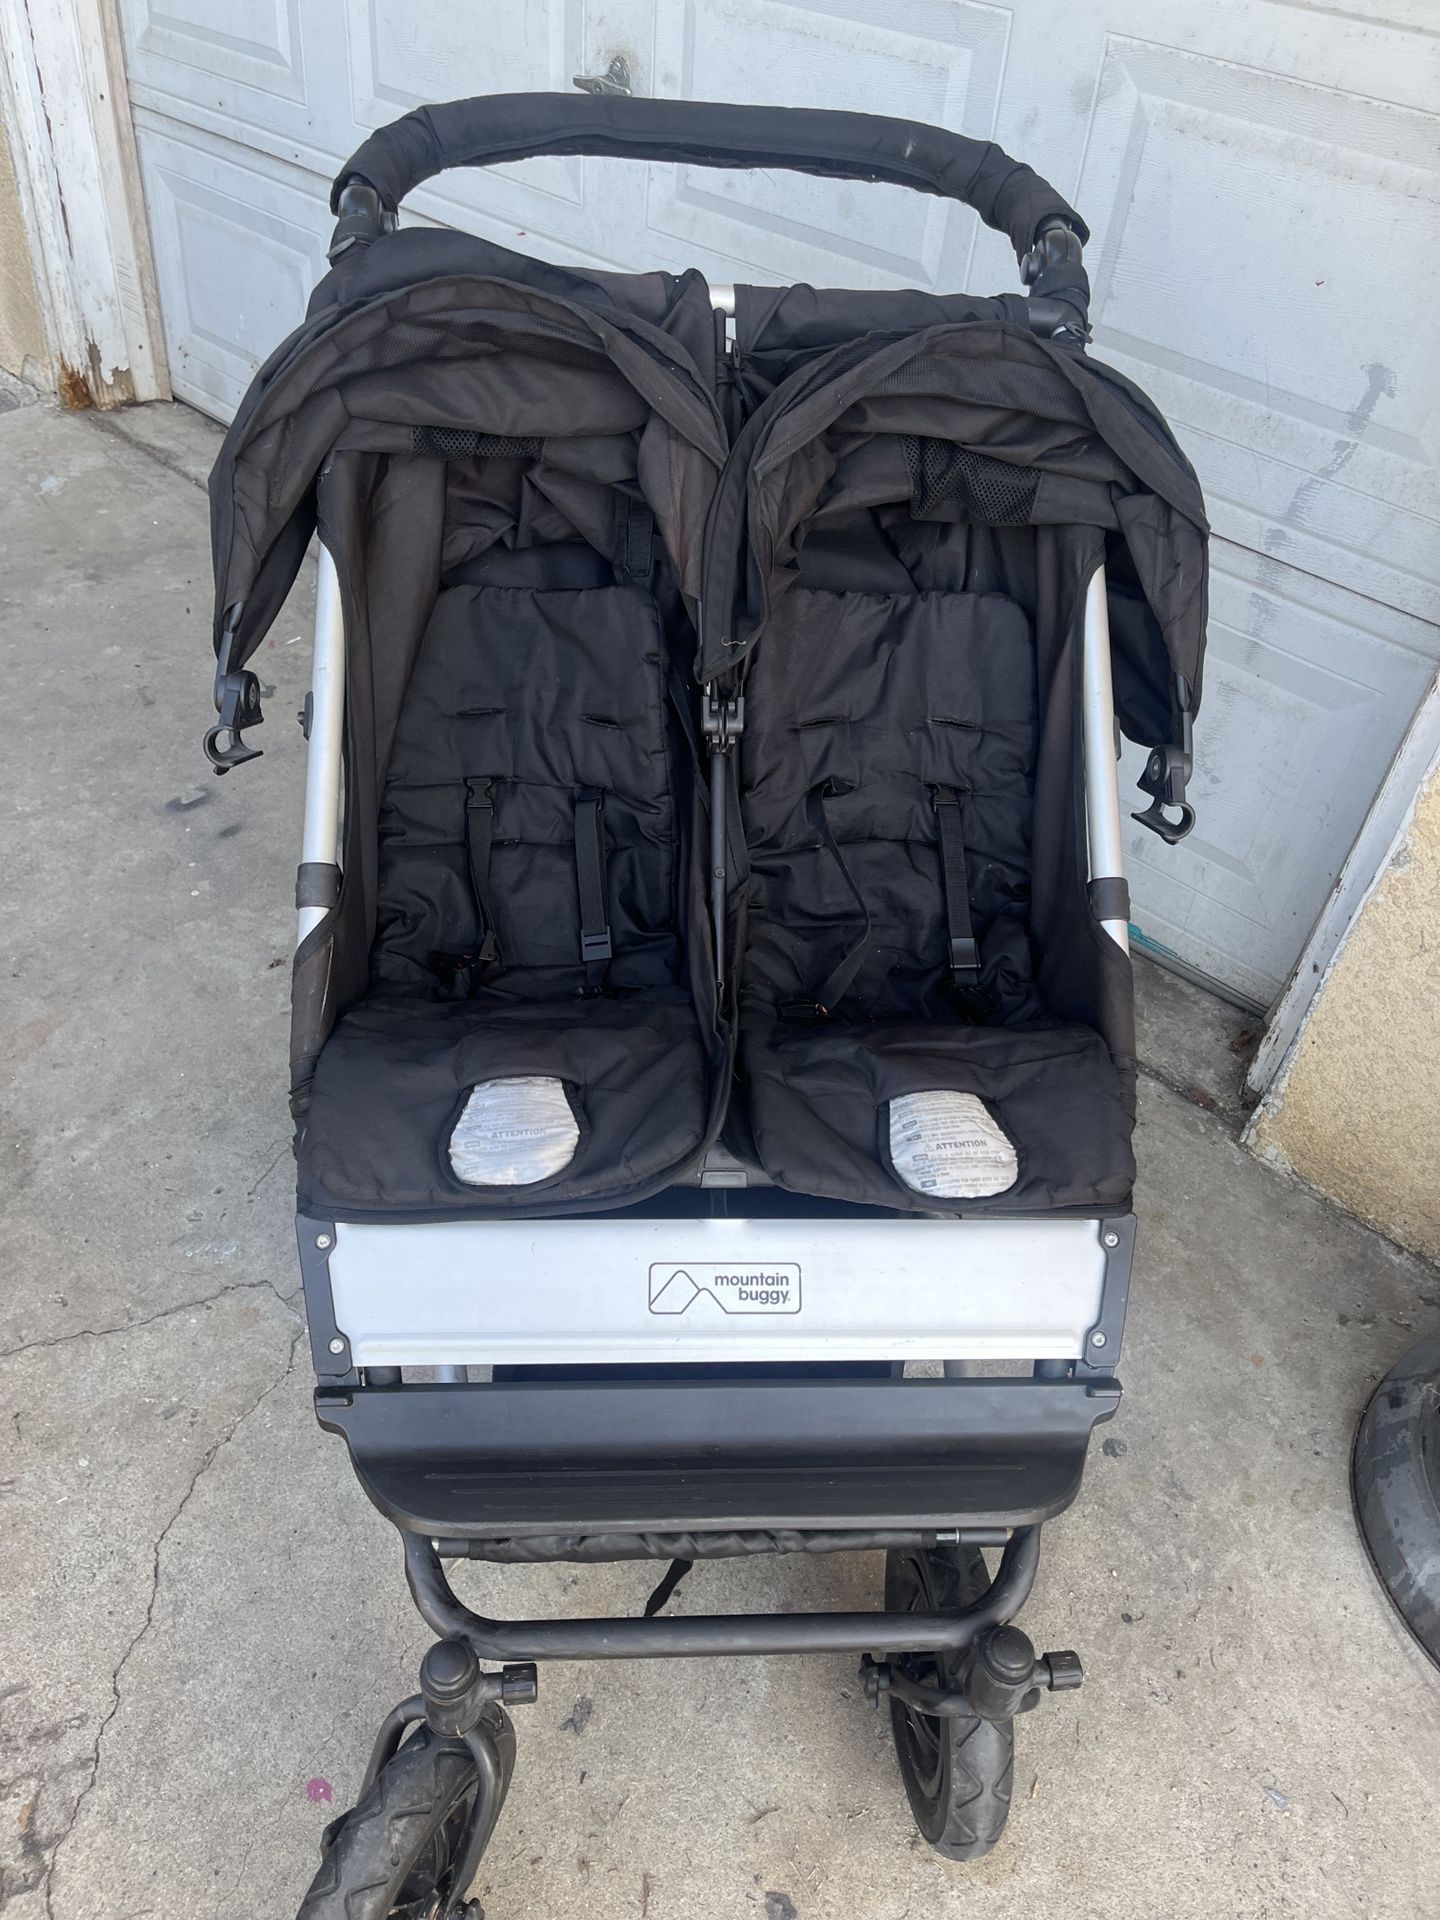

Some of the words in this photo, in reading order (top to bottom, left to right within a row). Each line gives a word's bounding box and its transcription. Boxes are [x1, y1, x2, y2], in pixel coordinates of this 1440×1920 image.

[491, 1128, 547, 1140] ATTENTION
[935, 1139, 988, 1151] ATTENTION
[714, 1272, 790, 1287] mountain
